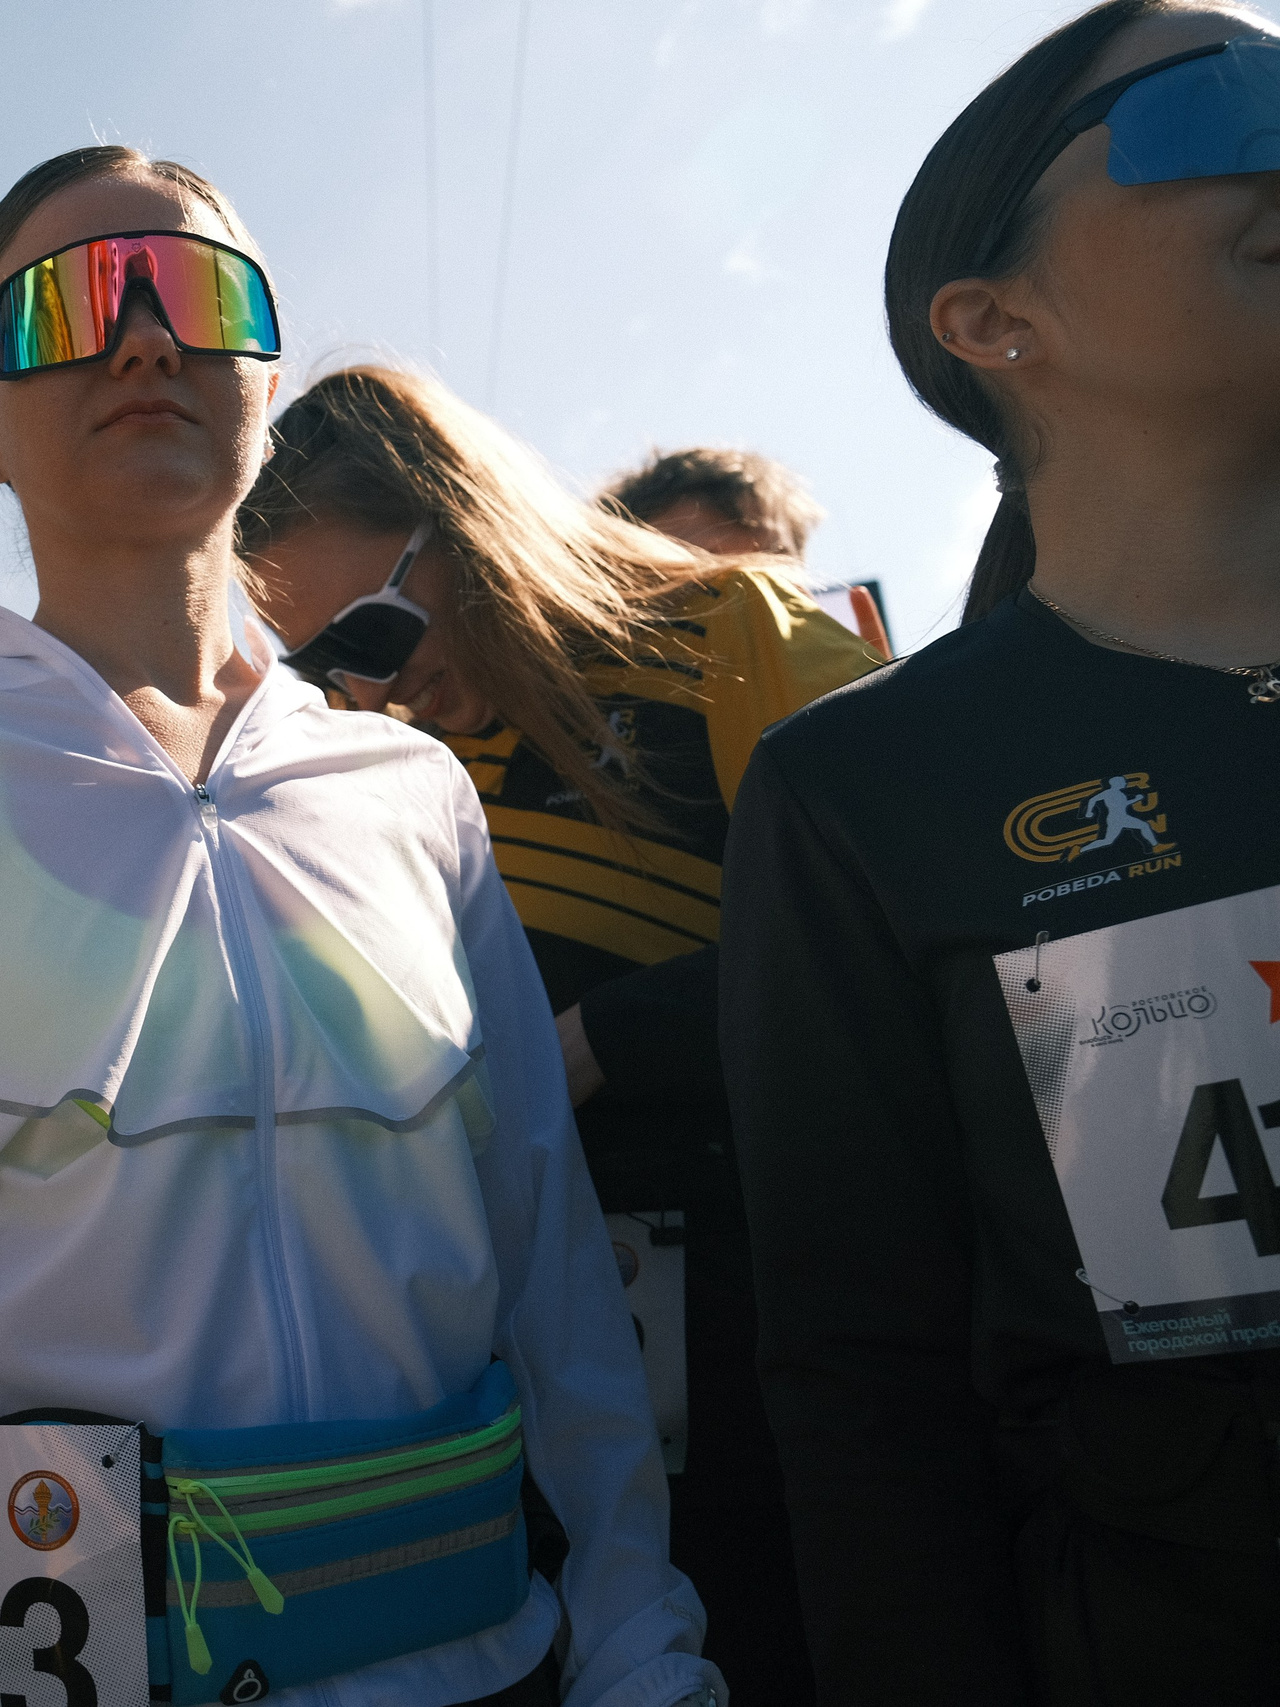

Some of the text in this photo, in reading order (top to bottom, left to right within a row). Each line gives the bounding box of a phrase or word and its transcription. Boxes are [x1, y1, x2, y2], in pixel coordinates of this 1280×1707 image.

[1022, 854, 1182, 907] POBEDA RUN
[1132, 985, 1207, 1007] РОСТОВСКОЕ
[1122, 1308, 1232, 1336] Ежегодный
[1128, 1319, 1280, 1355] городской проб
